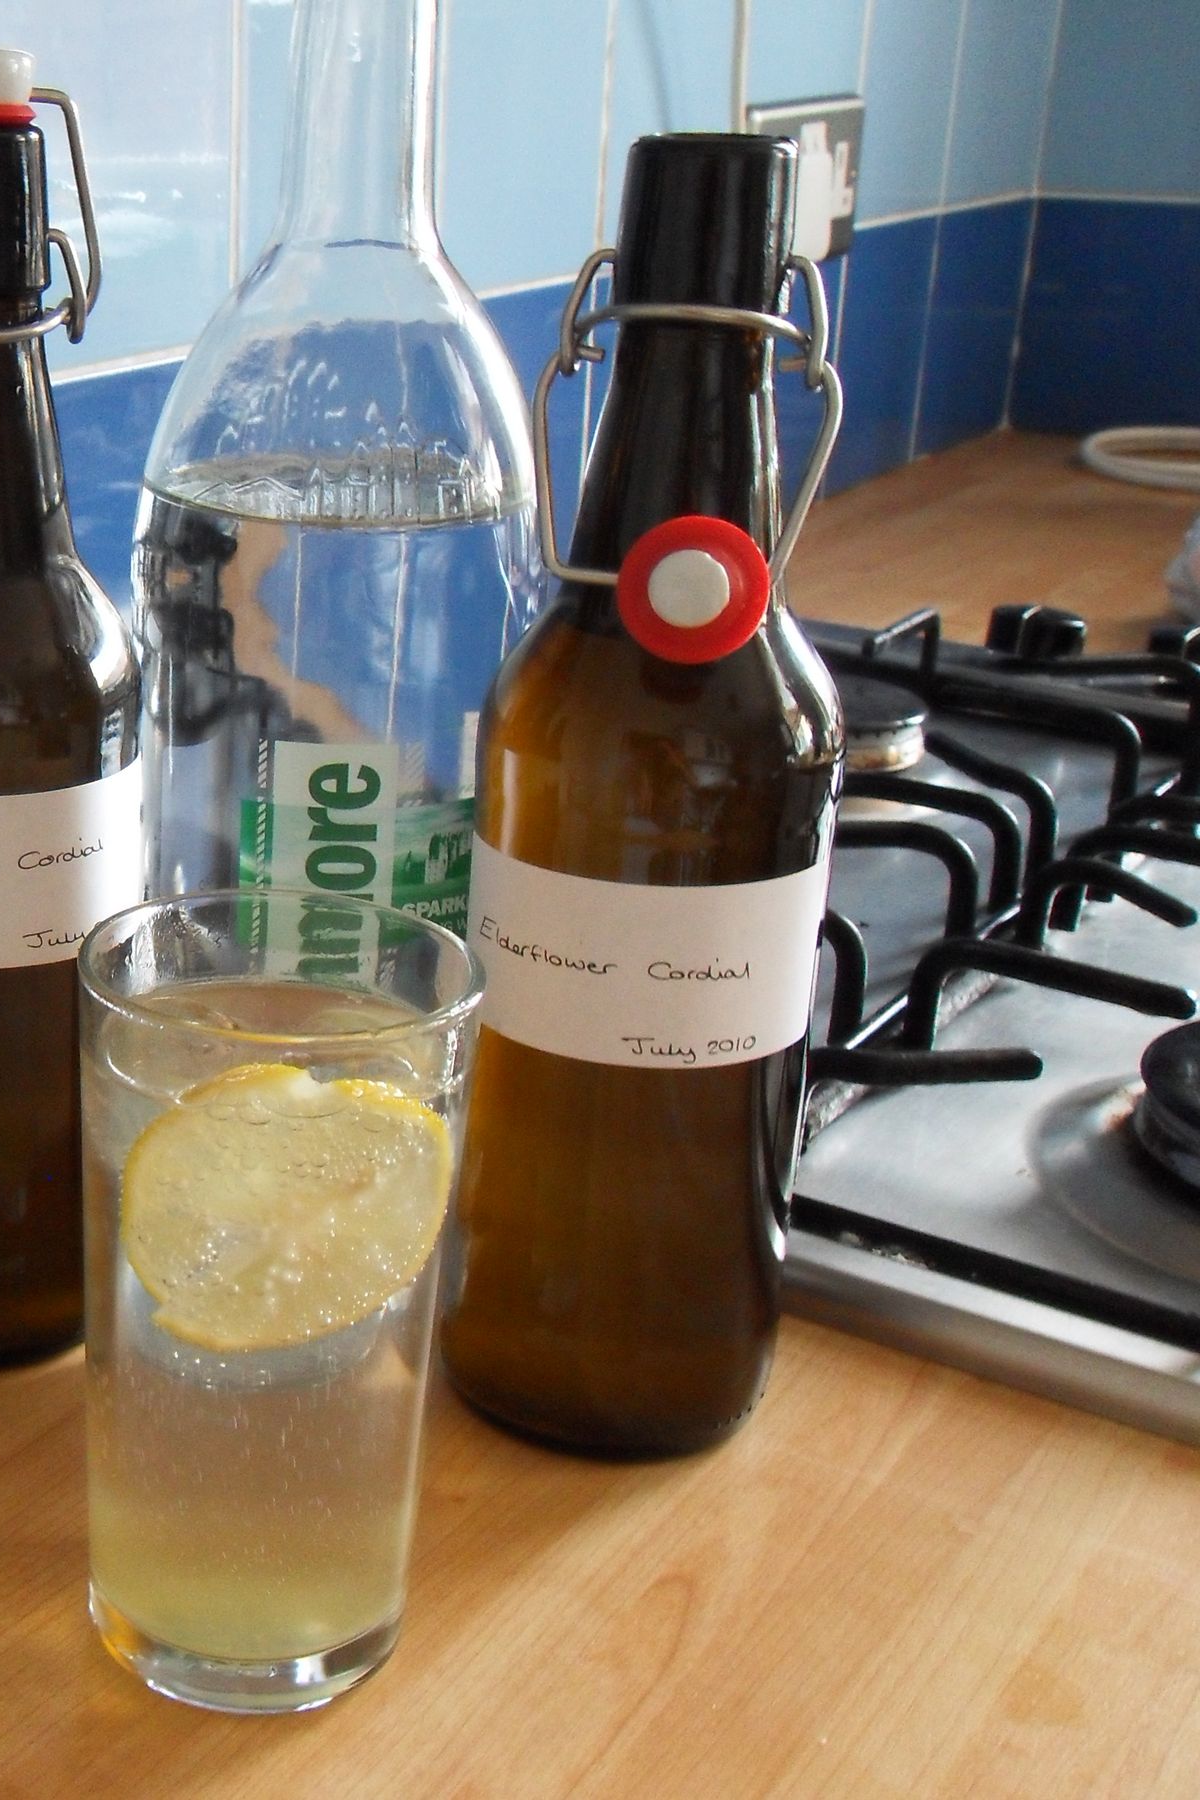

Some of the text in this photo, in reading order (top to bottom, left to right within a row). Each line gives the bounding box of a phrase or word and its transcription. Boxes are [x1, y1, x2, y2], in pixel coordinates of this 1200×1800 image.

[17, 837, 104, 871] Cordial
[478, 915, 751, 981] Elderflower Cordial
[621, 1035, 757, 1064] July 2010
